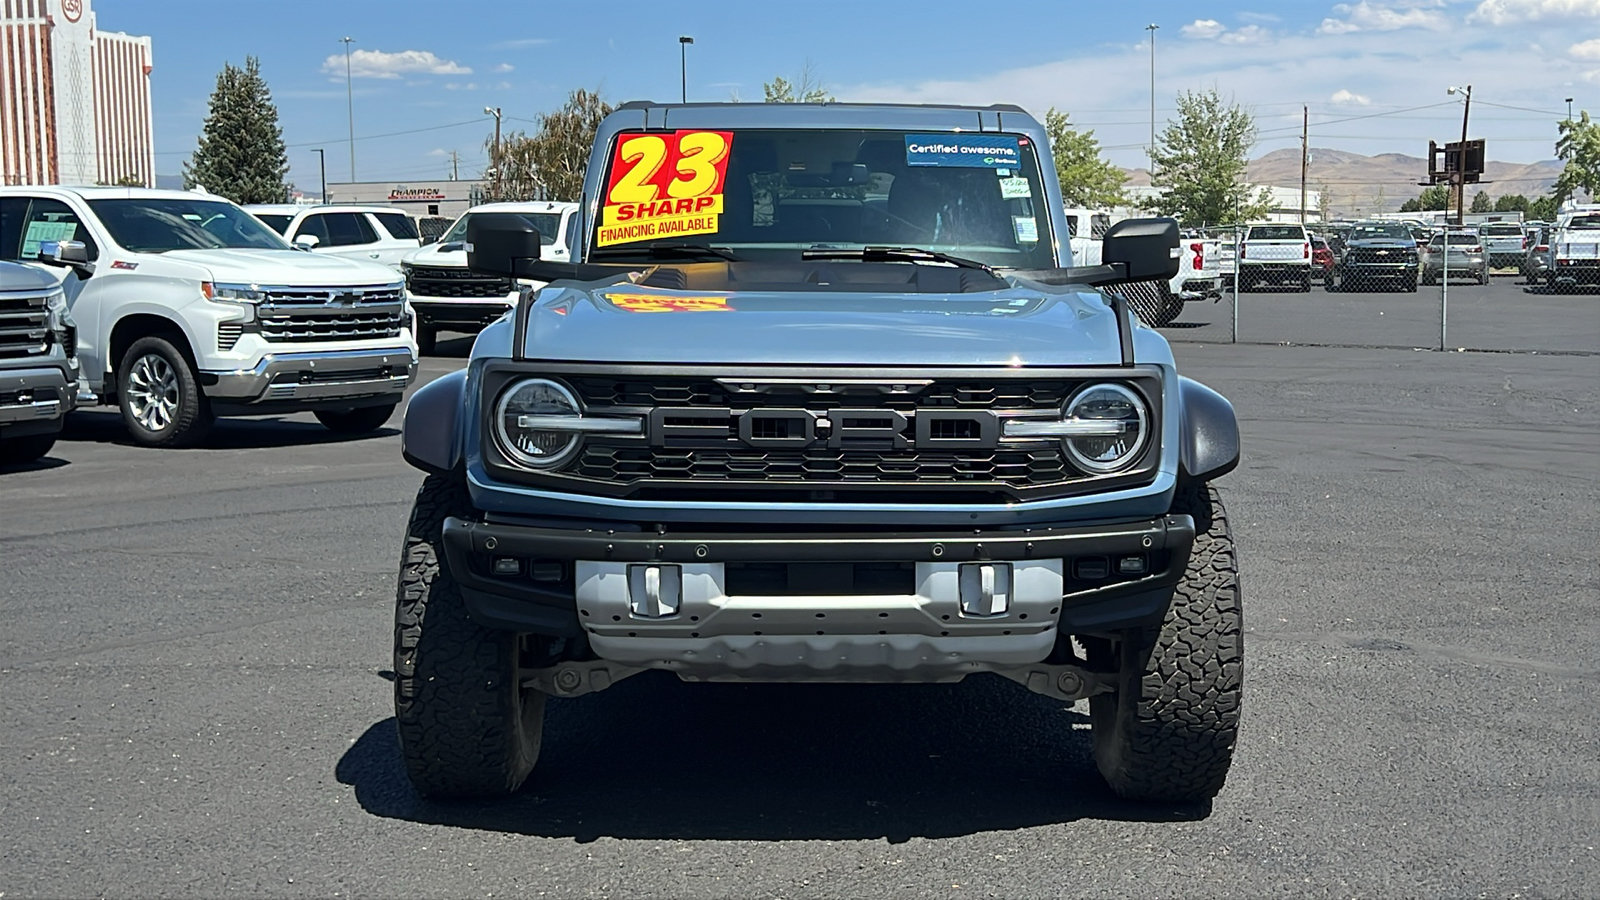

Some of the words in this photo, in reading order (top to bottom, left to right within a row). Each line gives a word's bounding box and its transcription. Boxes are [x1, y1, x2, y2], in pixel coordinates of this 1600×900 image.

[64, 0, 80, 13] GSR
[909, 144, 958, 154] Certified
[960, 145, 1016, 156] awesome.
[609, 132, 729, 203] 23
[391, 188, 440, 196] CHAMPION
[616, 196, 716, 221] SHARP
[600, 223, 655, 242] FINANCING
[657, 217, 714, 235] AVAILABLE
[650, 407, 1000, 449] FORD
